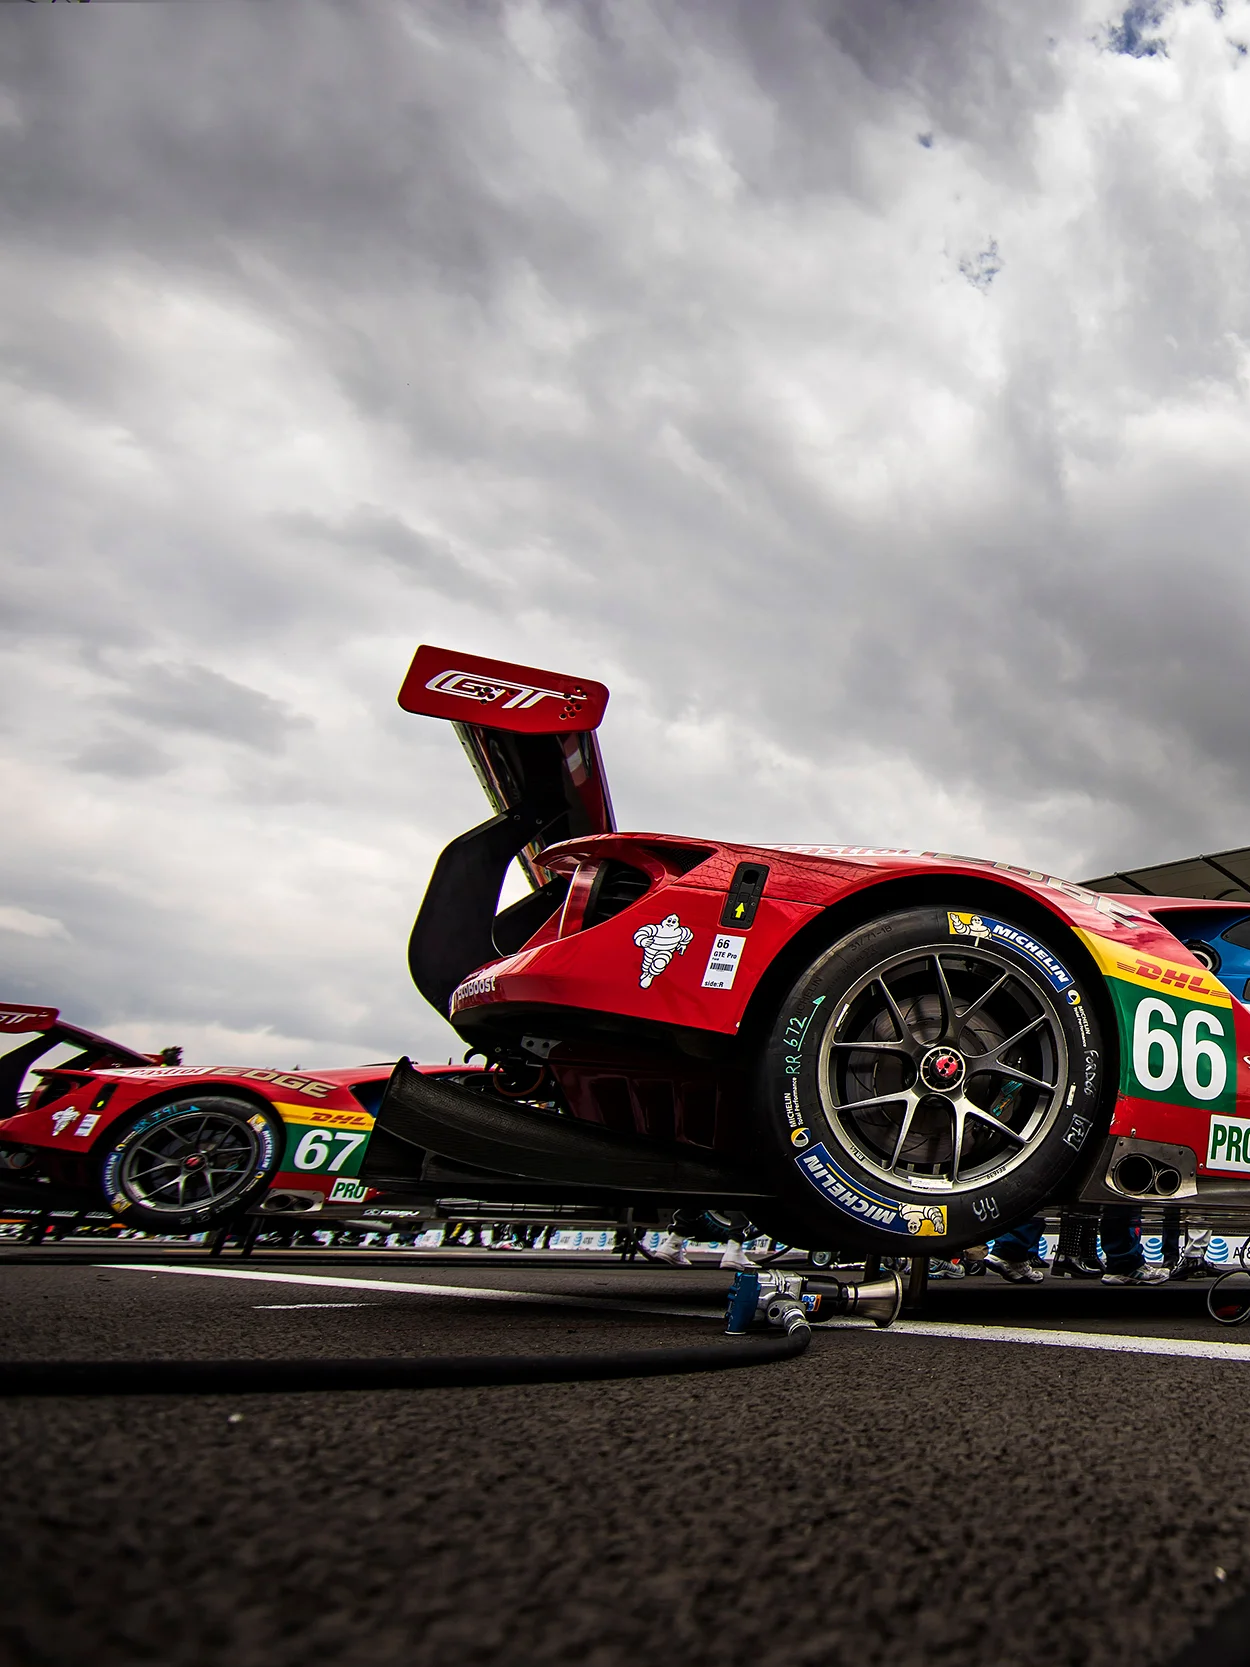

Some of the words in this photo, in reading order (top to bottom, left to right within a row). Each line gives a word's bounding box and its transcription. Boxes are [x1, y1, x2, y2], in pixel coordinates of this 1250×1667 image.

[425, 670, 587, 708] GT
[717, 938, 730, 949] 66
[993, 925, 1069, 983] MICHELIN
[1135, 959, 1211, 995] DHL
[785, 1054, 802, 1075] RR
[1133, 997, 1227, 1100] 66
[210, 1067, 337, 1098] EDGE
[310, 1112, 366, 1126] DHL
[784, 1092, 797, 1128] MICHELIN
[795, 1112, 803, 1125] Total
[294, 1129, 366, 1172] 67
[803, 1155, 897, 1225] MICHELIN
